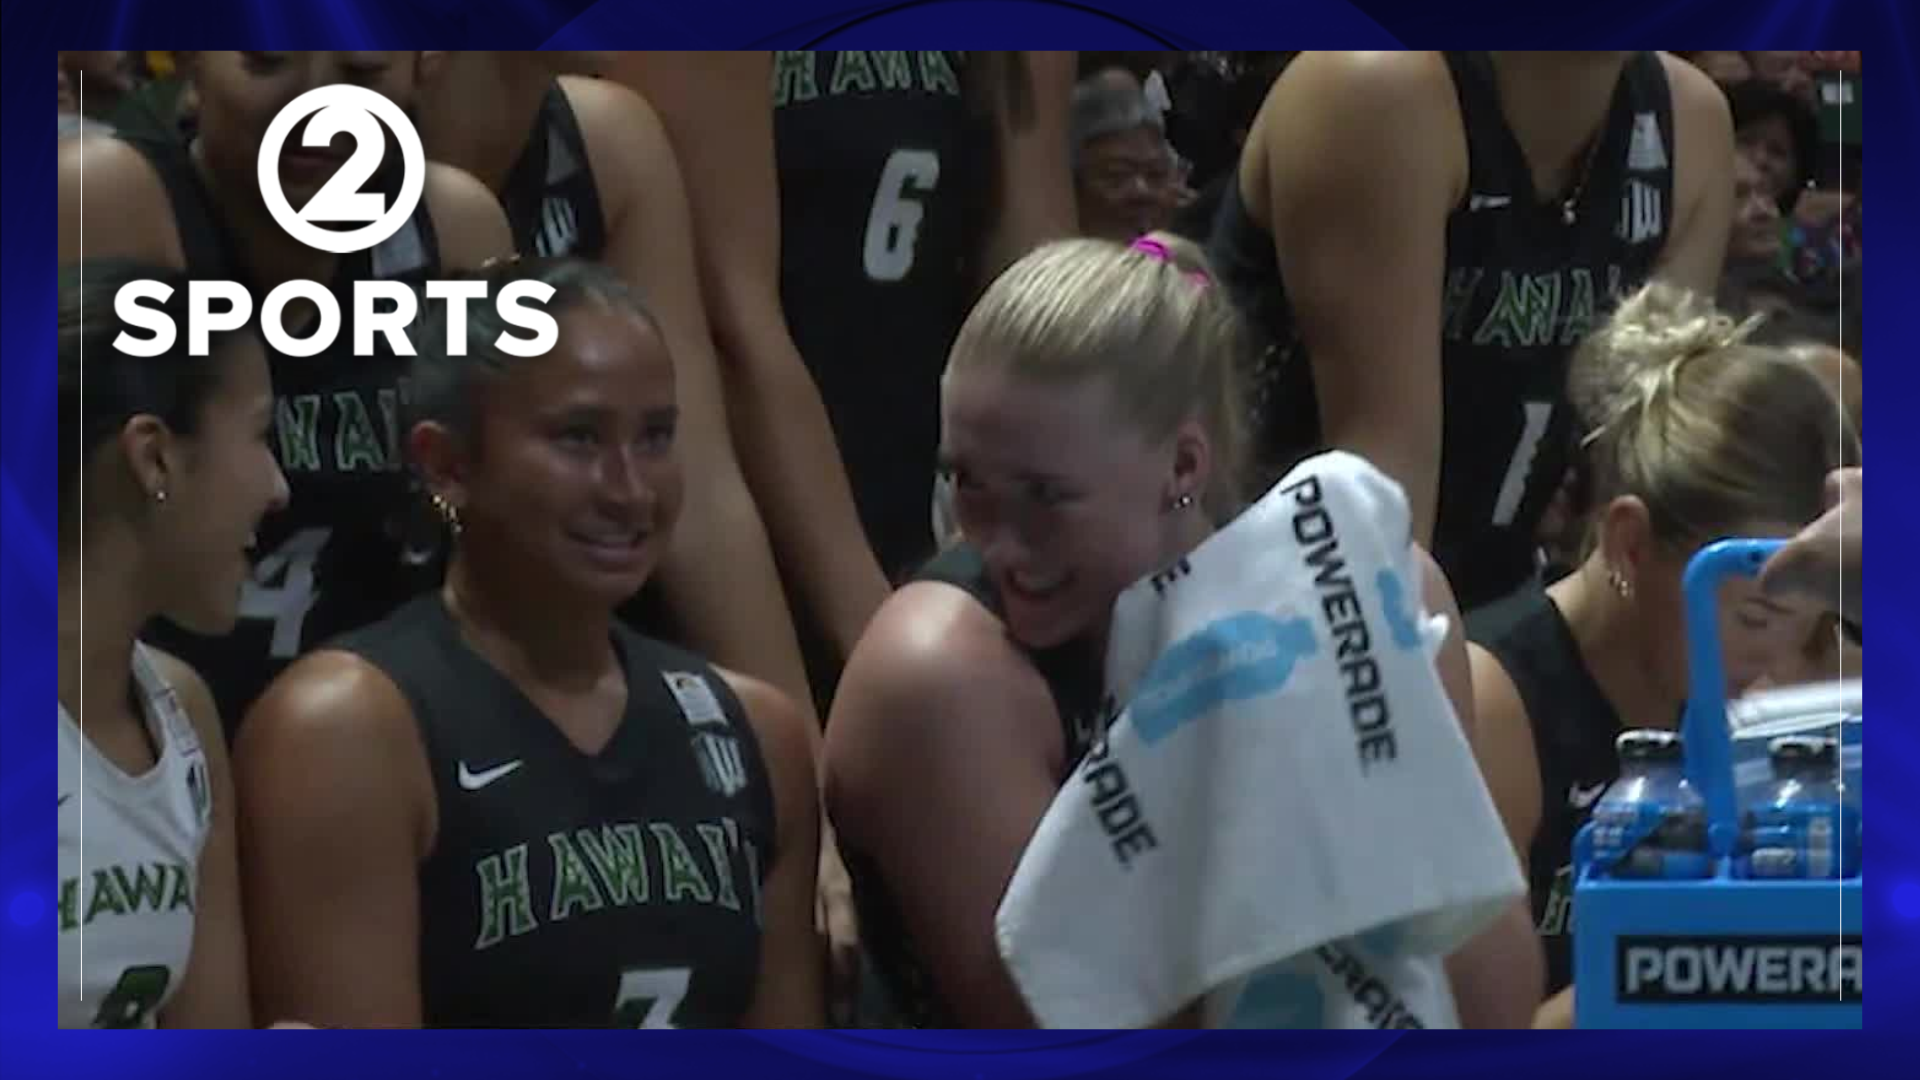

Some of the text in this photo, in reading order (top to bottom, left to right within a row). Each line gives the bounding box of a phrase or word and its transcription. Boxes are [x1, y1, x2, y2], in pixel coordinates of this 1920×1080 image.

[863, 148, 940, 281] 6
[238, 526, 333, 657] 4
[1626, 944, 1862, 995] POWERA
